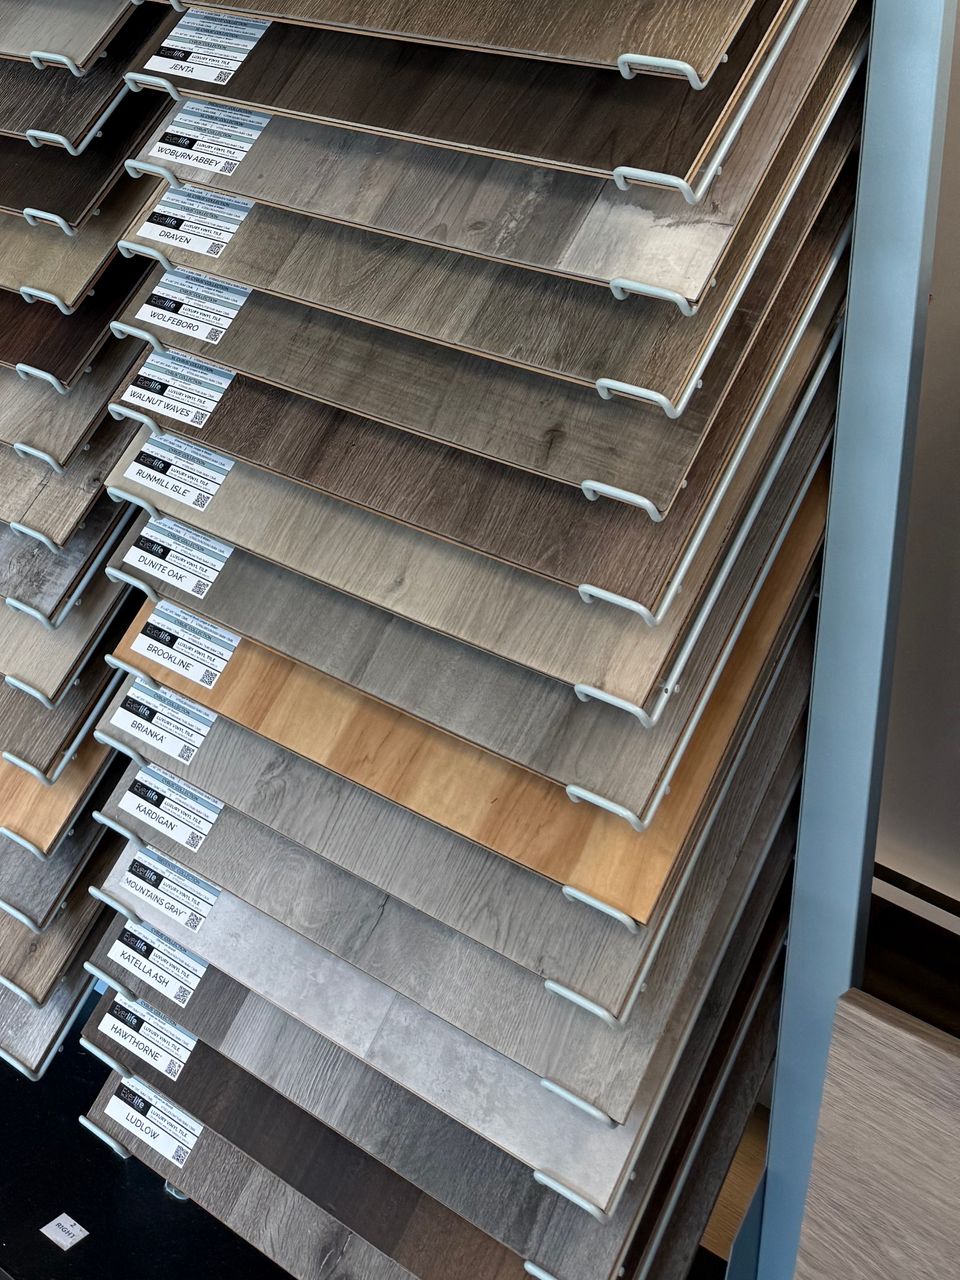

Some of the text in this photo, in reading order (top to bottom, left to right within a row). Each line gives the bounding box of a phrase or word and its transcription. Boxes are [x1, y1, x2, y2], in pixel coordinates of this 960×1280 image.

[170, 64, 195, 74] JENTA
[157, 146, 221, 168] WOBURN ABBEY
[158, 230, 192, 245] DRAVEN
[150, 310, 200, 332] WOLFEBORO
[130, 390, 191, 418] WALNUT WAVES
[136, 470, 189, 497] RUNMILL ISLE
[138, 555, 186, 582] DUNITE OAK
[146, 643, 191, 671] BROOKLINE
[130, 720, 165, 744] BRIANKA
[135, 803, 176, 831] KARDIGAN
[125, 876, 164, 906] MOUNTAINS
[164, 900, 184, 917] GRAY
[120, 950, 170, 988] KATELLA ASH
[110, 1023, 160, 1062] HAWTHORNE
[125, 1112, 160, 1141] LUDLOW
[56, 1222, 76, 1238] RIGHT
